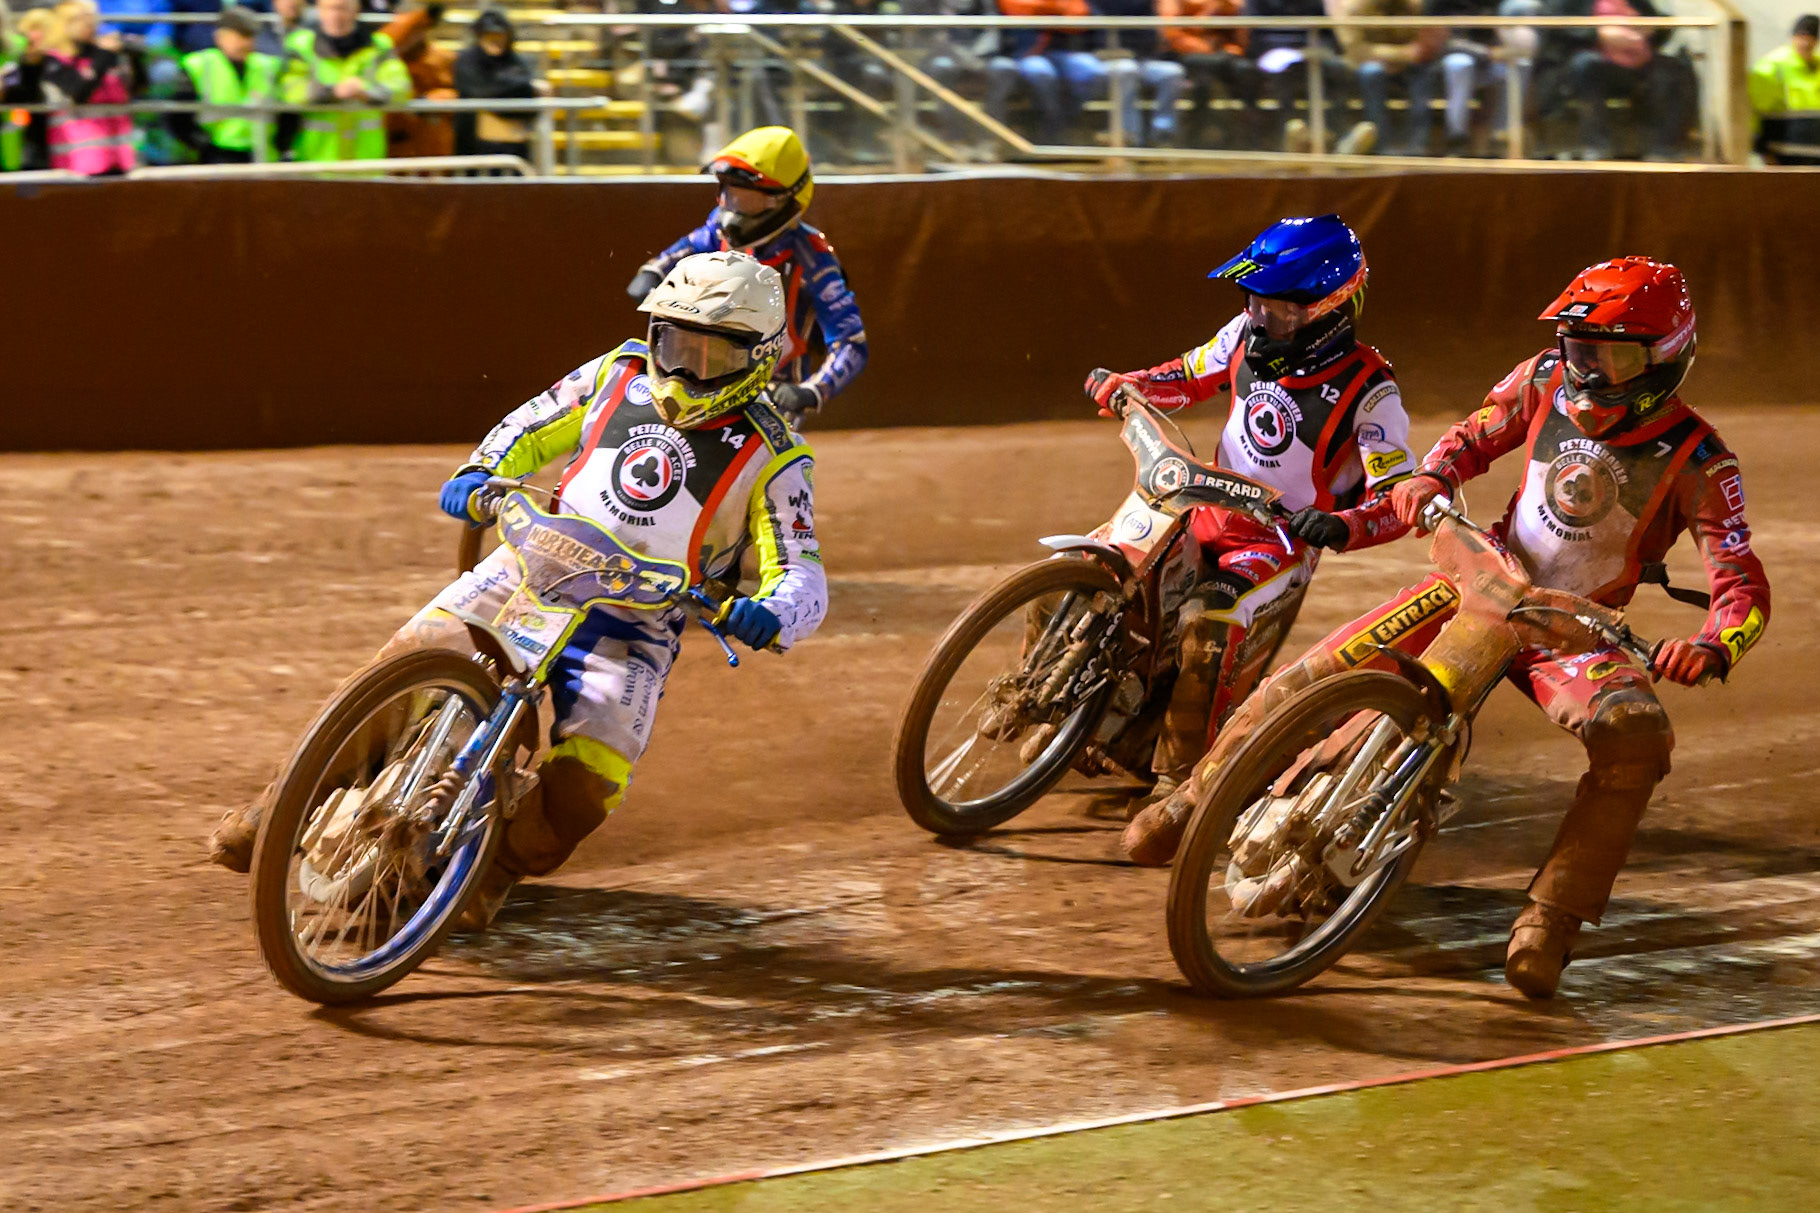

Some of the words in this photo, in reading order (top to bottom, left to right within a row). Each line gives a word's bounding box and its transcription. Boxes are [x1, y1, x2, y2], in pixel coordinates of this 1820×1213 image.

[1250, 380, 1276, 392] PETER
[1275, 385, 1304, 423] CRAVEN
[1320, 383, 1341, 404] 12
[628, 423, 666, 438] PETER
[664, 426, 697, 469] CRAVEN
[720, 426, 746, 450] 14
[1240, 435, 1281, 468] MEMORIAL
[1653, 440, 1672, 458] 7
[623, 439, 653, 455] BELLE
[655, 440, 674, 455] VUE
[670, 456, 681, 481] ACES
[1555, 454, 1582, 470] BELLE
[1559, 438, 1593, 453] PETER
[1592, 444, 1628, 485] CRAVEN
[599, 490, 656, 527] MEMORIAL
[1537, 505, 1593, 541] MEMORIAL
[1722, 512, 1745, 528] BET
[1376, 585, 1453, 642] ENTRACK
